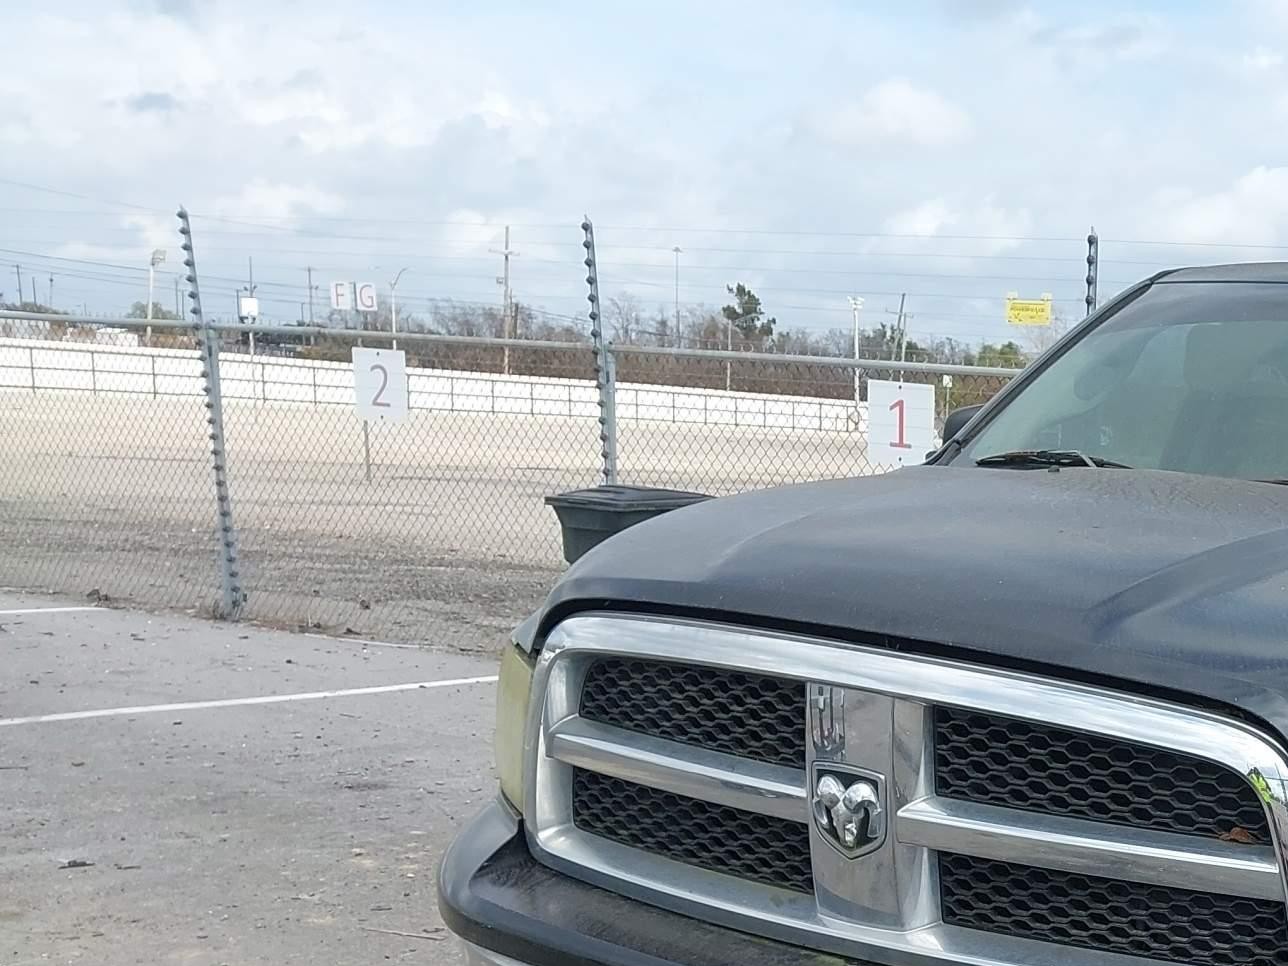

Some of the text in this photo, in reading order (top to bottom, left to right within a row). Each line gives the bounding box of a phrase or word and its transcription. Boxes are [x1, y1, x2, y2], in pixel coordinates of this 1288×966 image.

[334, 282, 345, 307] F
[359, 284, 375, 309] G
[369, 364, 391, 408] 2
[888, 399, 912, 450] 1
